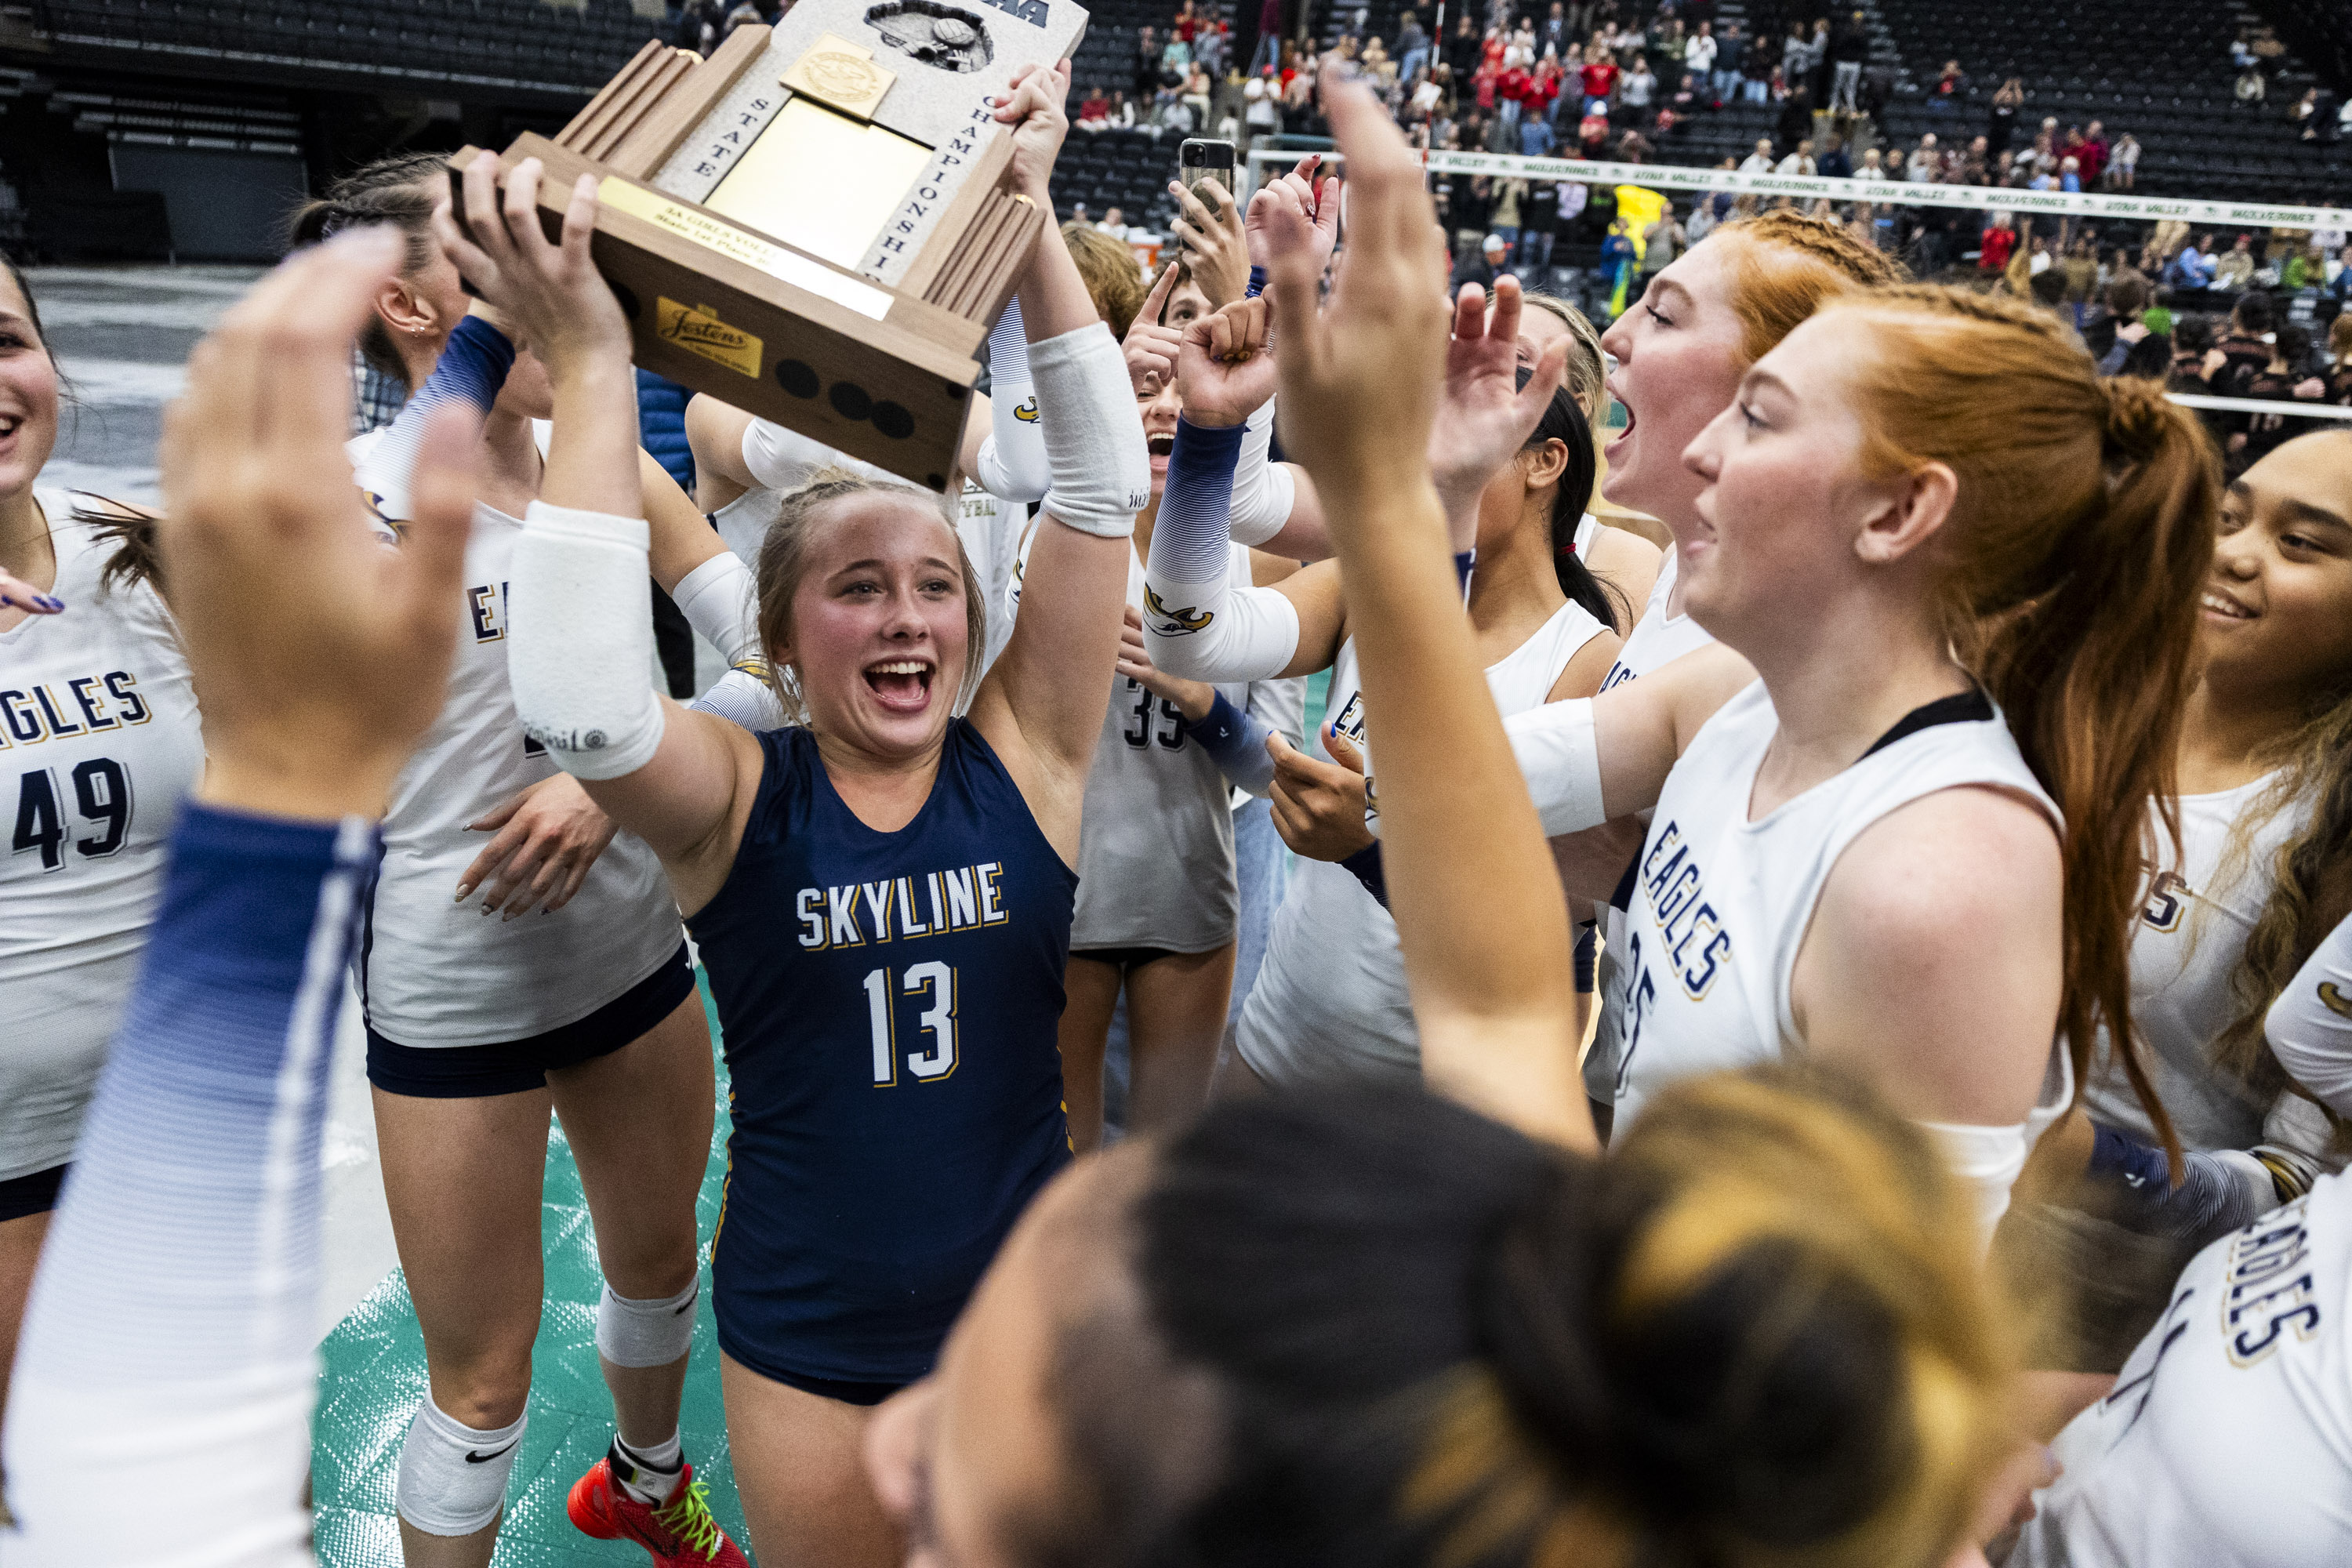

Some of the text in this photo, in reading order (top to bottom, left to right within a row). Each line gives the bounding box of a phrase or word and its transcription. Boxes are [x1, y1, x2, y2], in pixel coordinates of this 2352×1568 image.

[693, 98, 769, 177] STATE
[864, 95, 1000, 282] CHAMPIONSHI
[1634, 170, 1665, 181] UTAH
[1671, 172, 1712, 184] VALLEY
[1750, 177, 1830, 192] WOLVERINES
[1865, 187, 1897, 198] UTAH
[1904, 189, 1946, 200] VALLEY
[1985, 194, 2068, 209] WOLVERINES
[2104, 199, 2140, 212] UTAH
[2145, 202, 2189, 215] VALLEY
[2231, 209, 2316, 223] WOLVERINES
[466, 580, 509, 644] E
[0, 670, 153, 750] GLES
[12, 757, 134, 874] 49
[796, 860, 1010, 952] SKYLINE
[1641, 820, 1733, 1002] EAGLES
[862, 960, 960, 1089] 13
